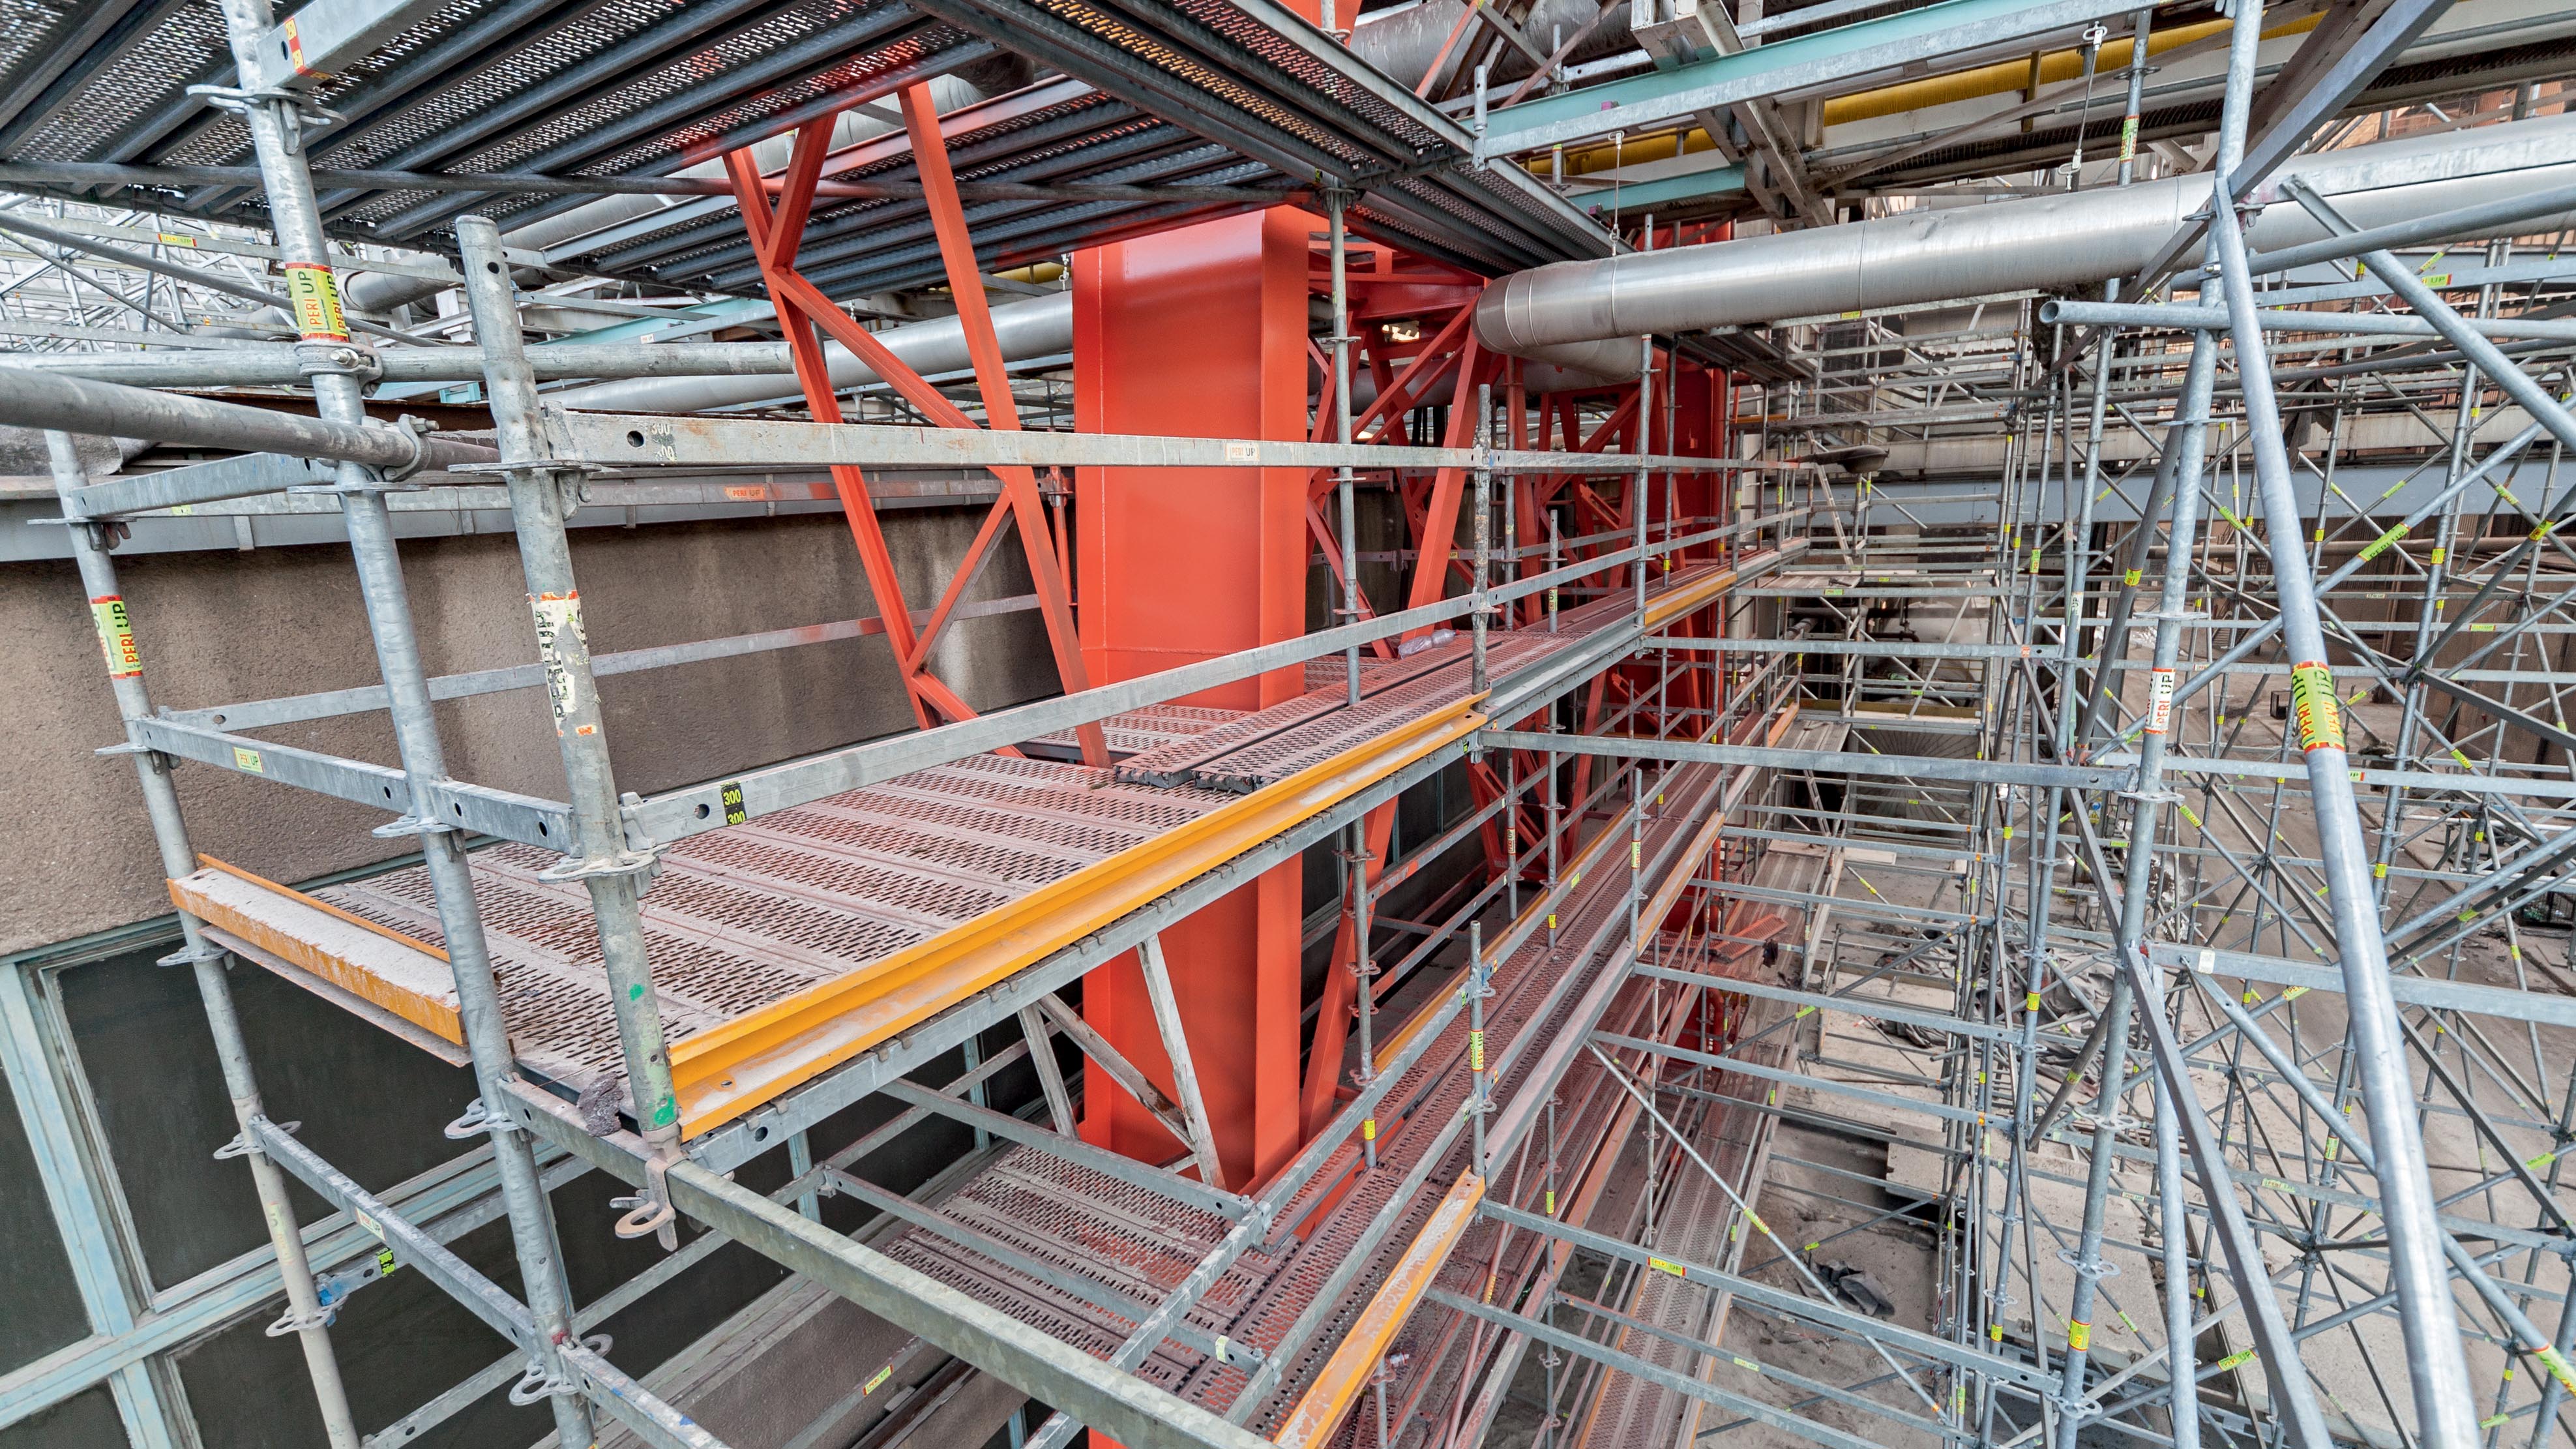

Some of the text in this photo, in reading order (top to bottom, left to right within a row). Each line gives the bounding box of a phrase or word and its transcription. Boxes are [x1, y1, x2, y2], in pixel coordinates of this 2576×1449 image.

[298, 271, 314, 293] UP
[306, 298, 322, 325] PERI
[333, 302, 346, 329] PERI
[1232, 447, 1256, 457] PERI UP
[2369, 531, 2404, 558] PERI UP
[113, 603, 139, 663] PERI UP
[2156, 674, 2172, 724] PERI UP
[2292, 675, 2315, 736] PERI UP
[723, 789, 741, 805] 300
